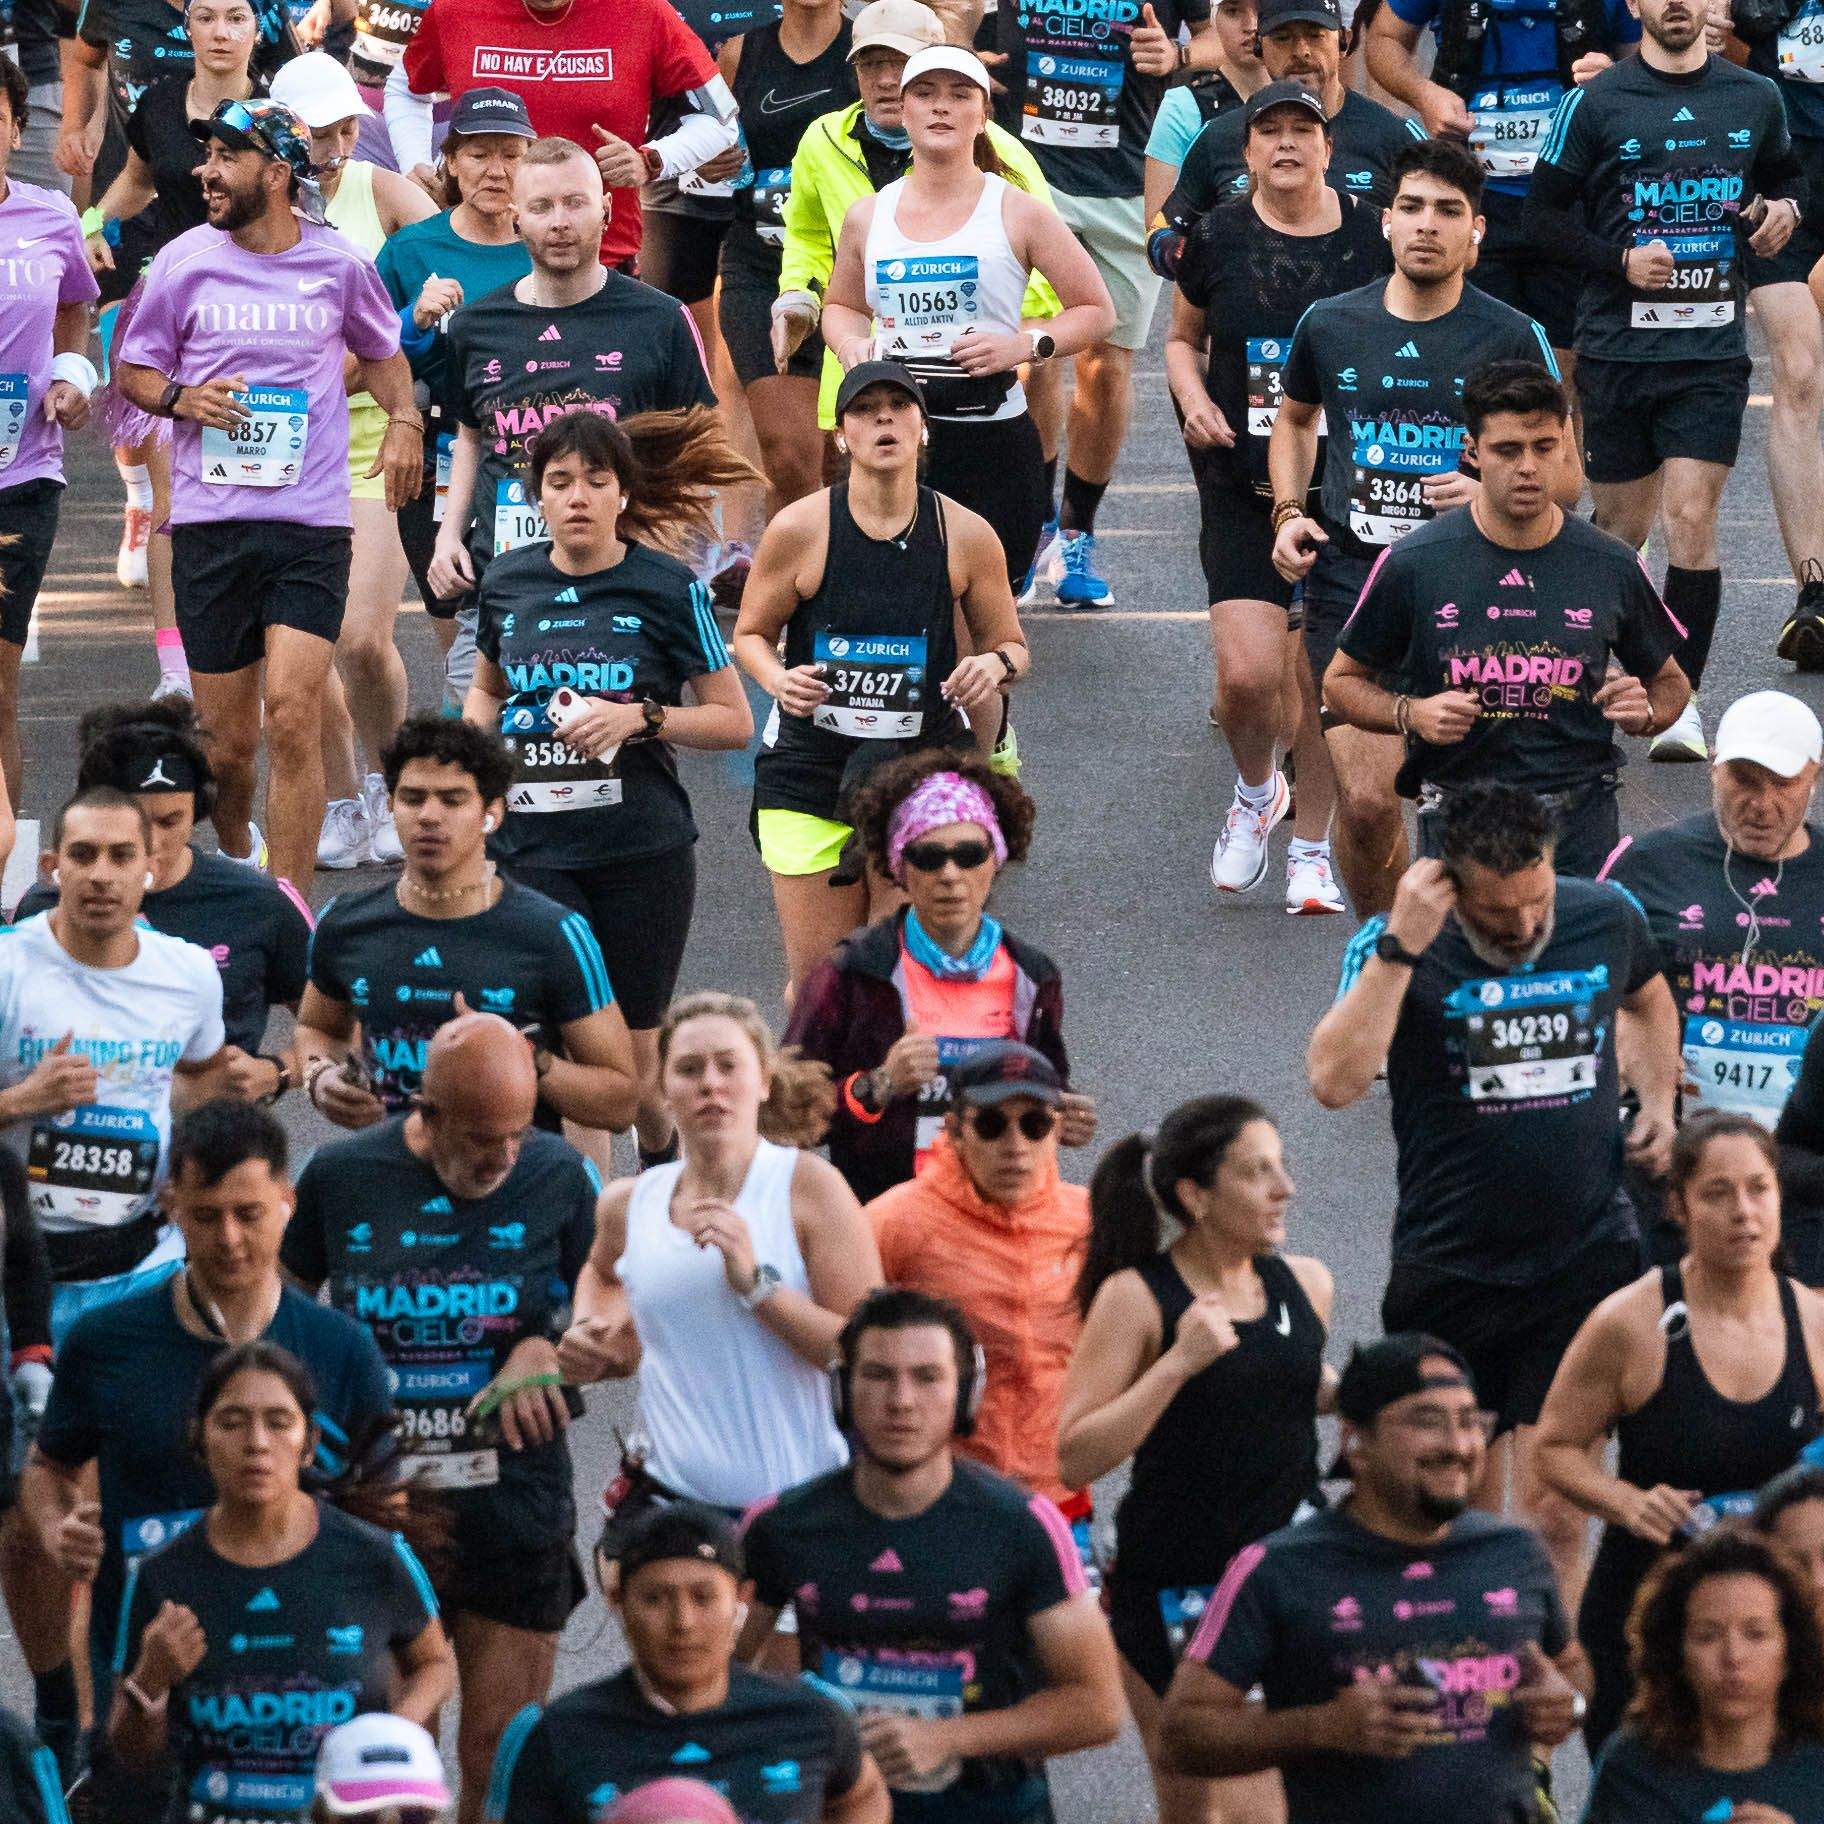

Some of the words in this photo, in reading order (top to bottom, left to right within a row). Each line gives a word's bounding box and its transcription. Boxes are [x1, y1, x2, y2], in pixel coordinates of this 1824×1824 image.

[1046, 17, 1111, 37] CIELO
[480, 53, 500, 72] NO
[504, 54, 533, 73] HAY
[537, 56, 604, 76] EXCUSAS
[1059, 62, 1108, 78] ZURICH
[471, 99, 519, 113] GERMANY
[1042, 87, 1101, 112] 38032
[1504, 91, 1550, 104] ZURICH
[1494, 120, 1539, 140] 8837
[1678, 139, 1706, 147] ZURICH
[1635, 177, 1743, 205] MADRID
[1660, 203, 1724, 224] CIELO
[1661, 226, 1708, 234] MARATHON
[1673, 240, 1719, 254] ZURICH
[911, 262, 961, 275] ZURICH
[898, 290, 958, 312] 10563
[197, 294, 328, 333] marro
[904, 316, 930, 326] ALLTID
[933, 315, 956, 324] AKTIV
[540, 360, 570, 370] ZURICH
[1397, 378, 1428, 387] ZURICH
[240, 393, 291, 405] ZURICH
[236, 445, 267, 457] MARRO
[1390, 453, 1442, 466] ZURICH
[1381, 505, 1406, 516] DIEGO
[1409, 505, 1421, 516] XD
[1501, 607, 1536, 619] ZURICH
[553, 618, 586, 629] ZURICH
[856, 641, 909, 656] ZURICH
[506, 663, 634, 690] MADRID
[1450, 655, 1583, 688] MADRID
[835, 670, 903, 696] 37627
[849, 697, 885, 709] DAYANA
[1482, 685, 1553, 710] CIELO
[1510, 979, 1572, 999] ZURICH
[1729, 994, 1807, 1024] CIELO
[1492, 1017, 1569, 1050] 36239
[1730, 1027, 1792, 1046] ZURICH
[1712, 1060, 1773, 1090] 9417
[85, 1112, 144, 1131] ZURICH
[56, 1143, 132, 1177] 28358
[356, 1286, 519, 1318] MADRID
[395, 1317, 484, 1344] CIELO
[407, 1372, 470, 1390] ZURICH
[191, 1692, 356, 1730] MADRID
